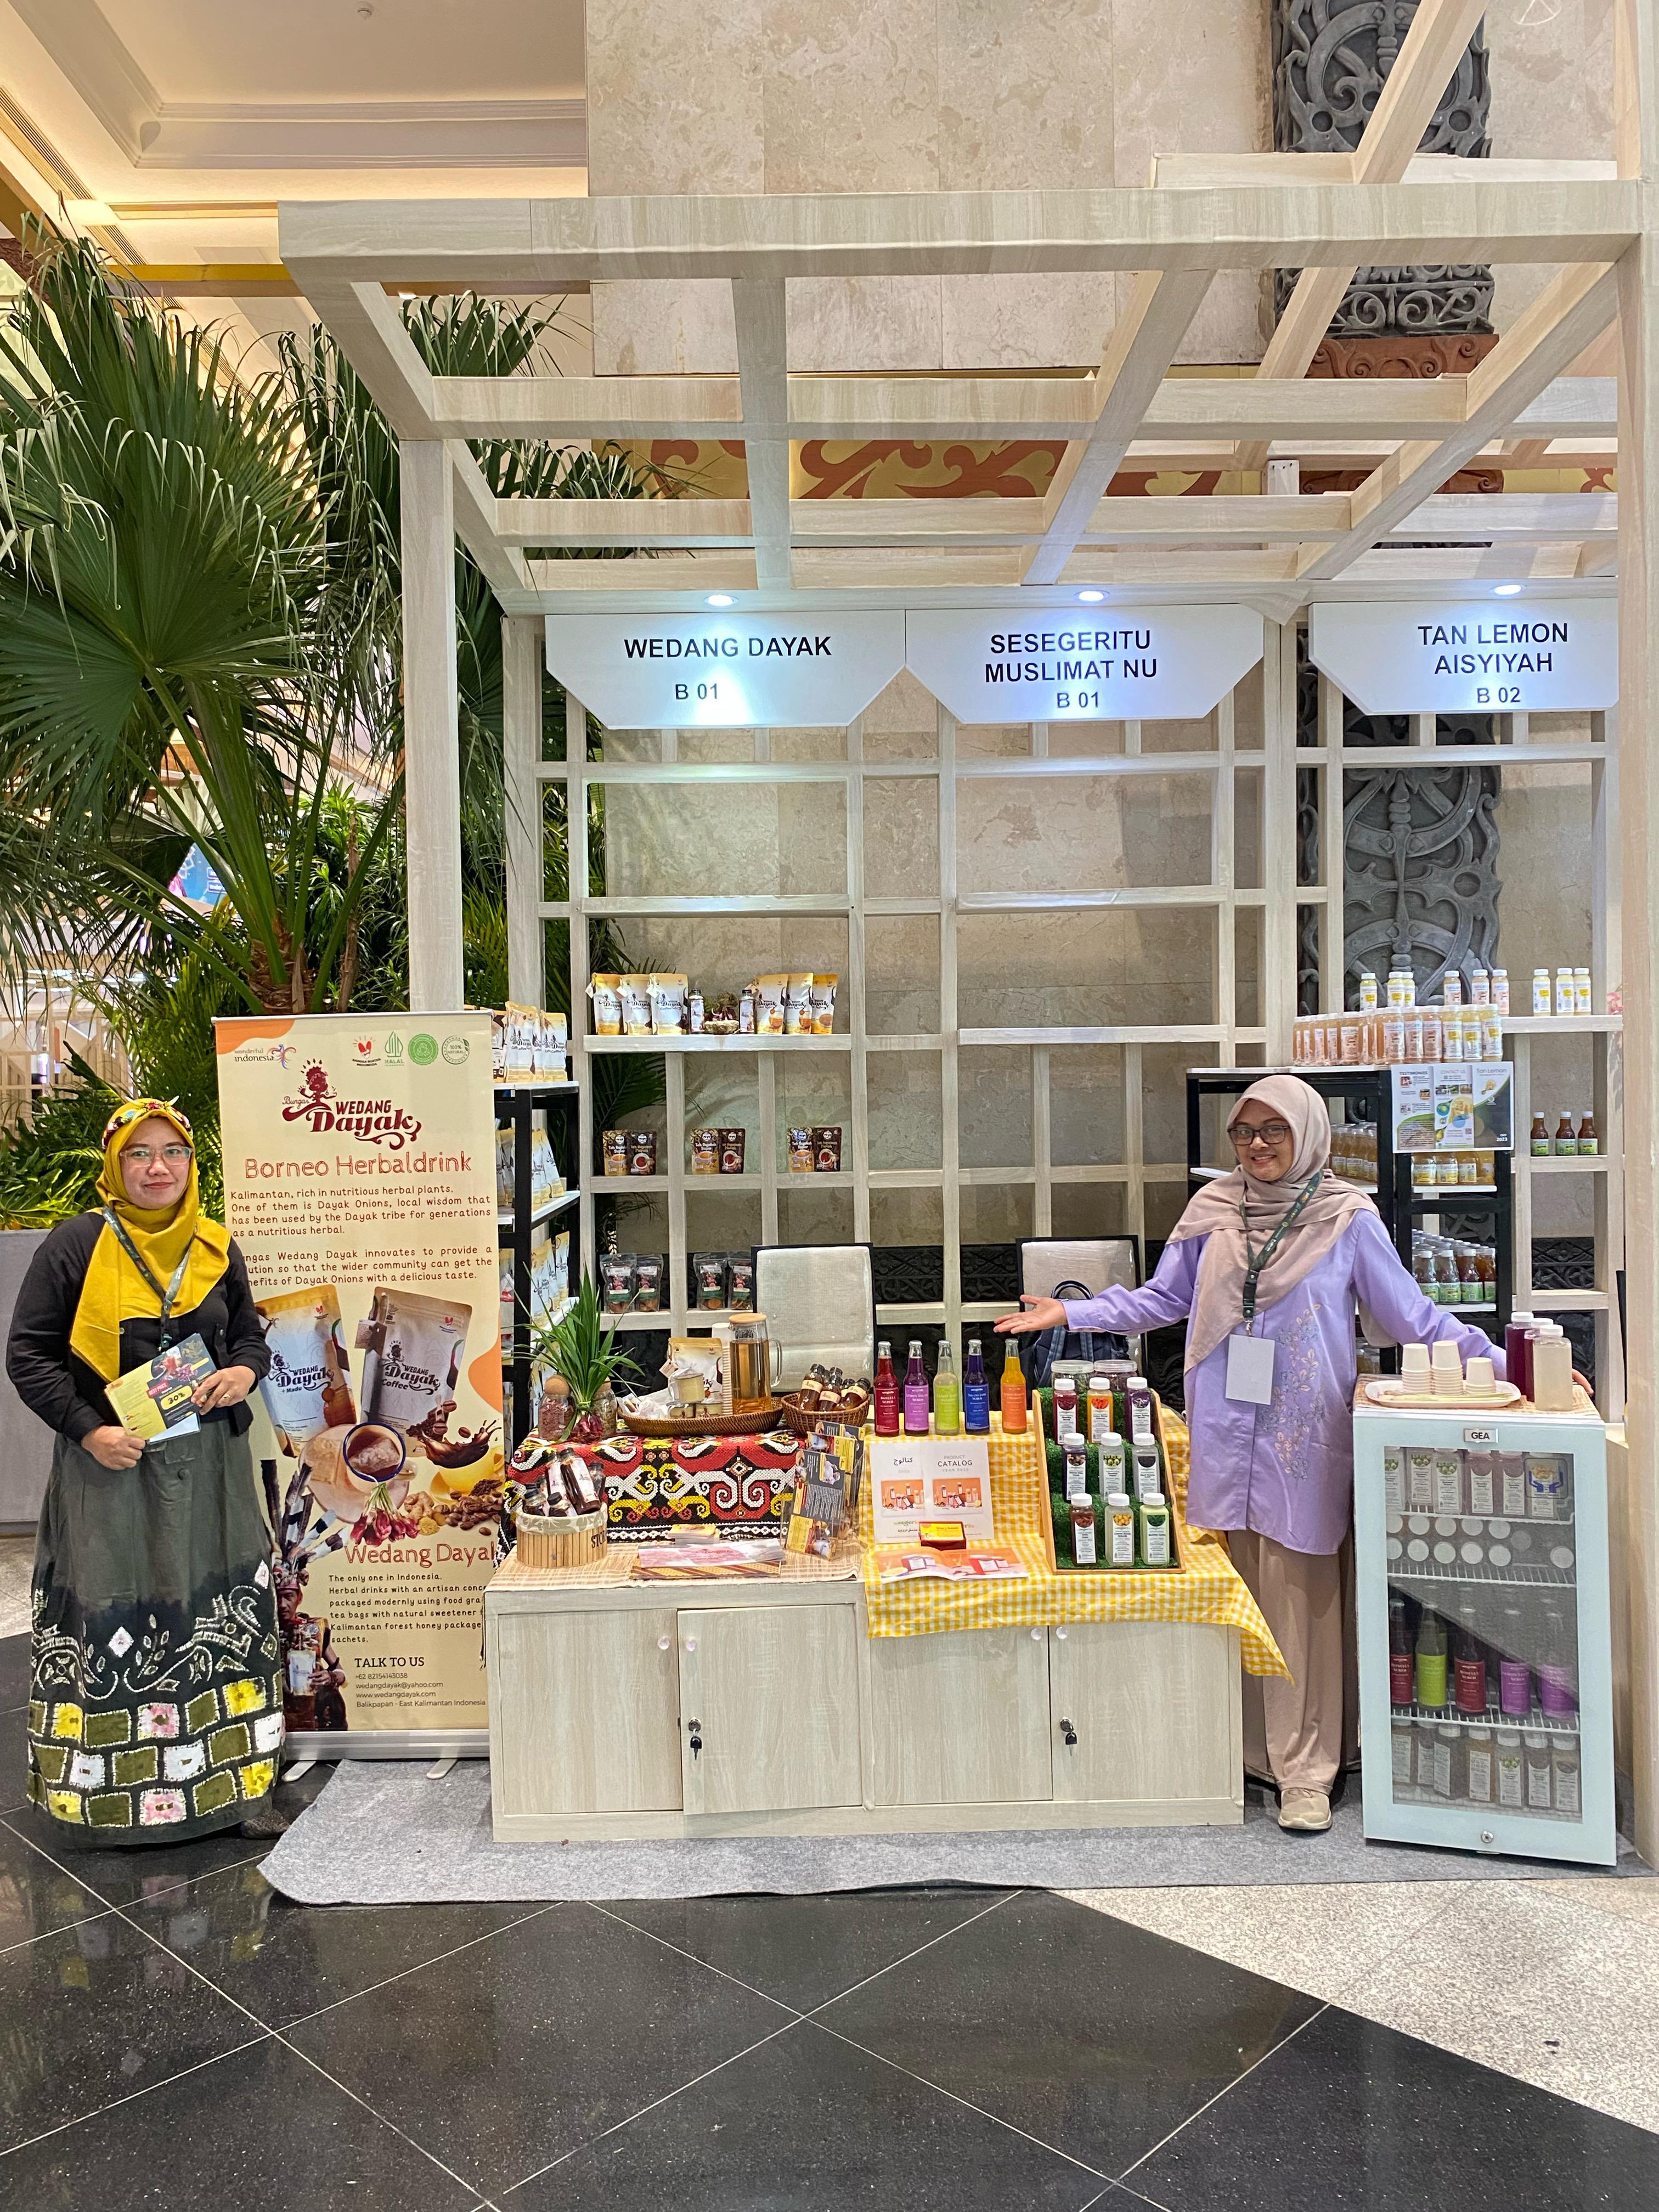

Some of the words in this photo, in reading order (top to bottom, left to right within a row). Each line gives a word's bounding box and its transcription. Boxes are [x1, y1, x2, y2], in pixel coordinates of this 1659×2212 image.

[991, 630, 1150, 653] SESEGERITU
[1418, 625, 1466, 645] TAN
[1478, 623, 1567, 644] LEMON
[624, 639, 738, 658] WEDANG
[749, 636, 832, 656] DAYAK
[986, 661, 1114, 682] MUSLIMAT
[1124, 659, 1156, 678] NU
[1435, 653, 1551, 674] AISYIYAH
[675, 684, 689, 699] B
[698, 684, 716, 699] 01
[1477, 688, 1489, 703] B
[1498, 687, 1520, 703] 02
[1057, 693, 1070, 708] B
[1079, 692, 1098, 708] 01
[282, 1096, 309, 1109] Bungas
[336, 1100, 392, 1115] WEDANG
[306, 1109, 421, 1143] Dayak
[246, 1159, 329, 1178] Borneo
[336, 1151, 471, 1176] Herbaldrink
[231, 1191, 293, 1199] Kalimantan,
[297, 1189, 315, 1197] rich
[330, 1187, 379, 1196] nutritious
[383, 1186, 414, 1194] herbal
[418, 1185, 453, 1195] plants.
[232, 1204, 250, 1212] One
[318, 1200, 349, 1210] Dayak
[356, 1199, 392, 1207] Onions,
[398, 1198, 420, 1206] local
[427, 1197, 461, 1205] wisdom
[282, 1214, 304, 1222] used
[309, 1214, 320, 1223] by
[325, 1213, 341, 1221] the
[346, 1212, 377, 1222] Dayak
[430, 1209, 490, 1220] generations
[258, 1227, 306, 1236] nutritious
[311, 1226, 344, 1234] herbal.
[245, 1255, 269, 1263] ngas
[278, 1252, 318, 1261] Wedang
[326, 1250, 358, 1260] Dayak
[365, 1249, 415, 1257] innovates
[441, 1246, 477, 1257] provide
[249, 1265, 273, 1273] ution
[373, 1260, 426, 1270] community
[455, 1259, 470, 1268] get
[476, 1257, 492, 1266] the
[249, 1278, 278, 1286] nefits
[281, 1277, 292, 1285] of
[296, 1276, 328, 1285] Dayak
[331, 1274, 363, 1283] Onions
[367, 1273, 387, 1282] with
[400, 1272, 442, 1280] delicious
[293, 1365, 318, 1376] WEDANG
[404, 1364, 428, 1375] WEDANG
[276, 1367, 334, 1390] Dayak
[382, 1379, 408, 1390] Coffee
[385, 1365, 440, 1391] Dayak
[1471, 1431, 1490, 1440] GEA
[344, 1543, 432, 1568] Wedang
[330, 1599, 371, 1607] packaged
[375, 1598, 414, 1606] modernly
[418, 1598, 440, 1606] using
[349, 1611, 368, 1620] bags
[445, 1621, 481, 1629] package
[354, 1658, 387, 1667] TALK
[390, 1657, 406, 1667] TO
[409, 1657, 424, 1666] US
